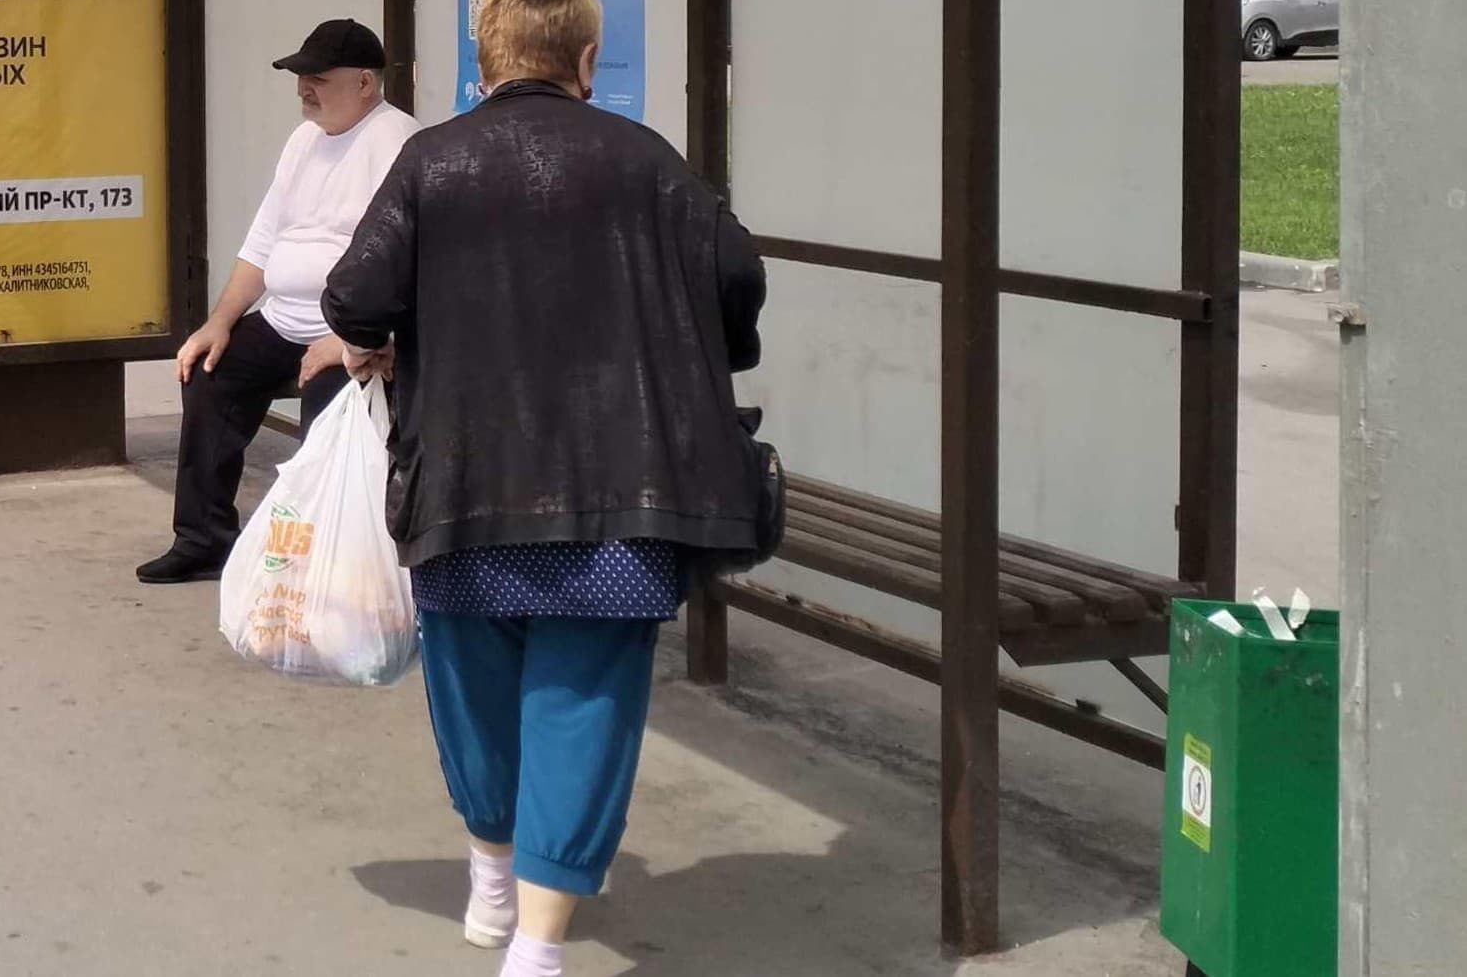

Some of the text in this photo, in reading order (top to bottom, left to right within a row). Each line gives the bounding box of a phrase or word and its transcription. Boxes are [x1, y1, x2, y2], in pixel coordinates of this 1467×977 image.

[24, 188, 95, 213] ПР-КТ,
[99, 187, 133, 208] 173
[11, 263, 33, 276] ИНН
[34, 261, 92, 274] 4345164751,
